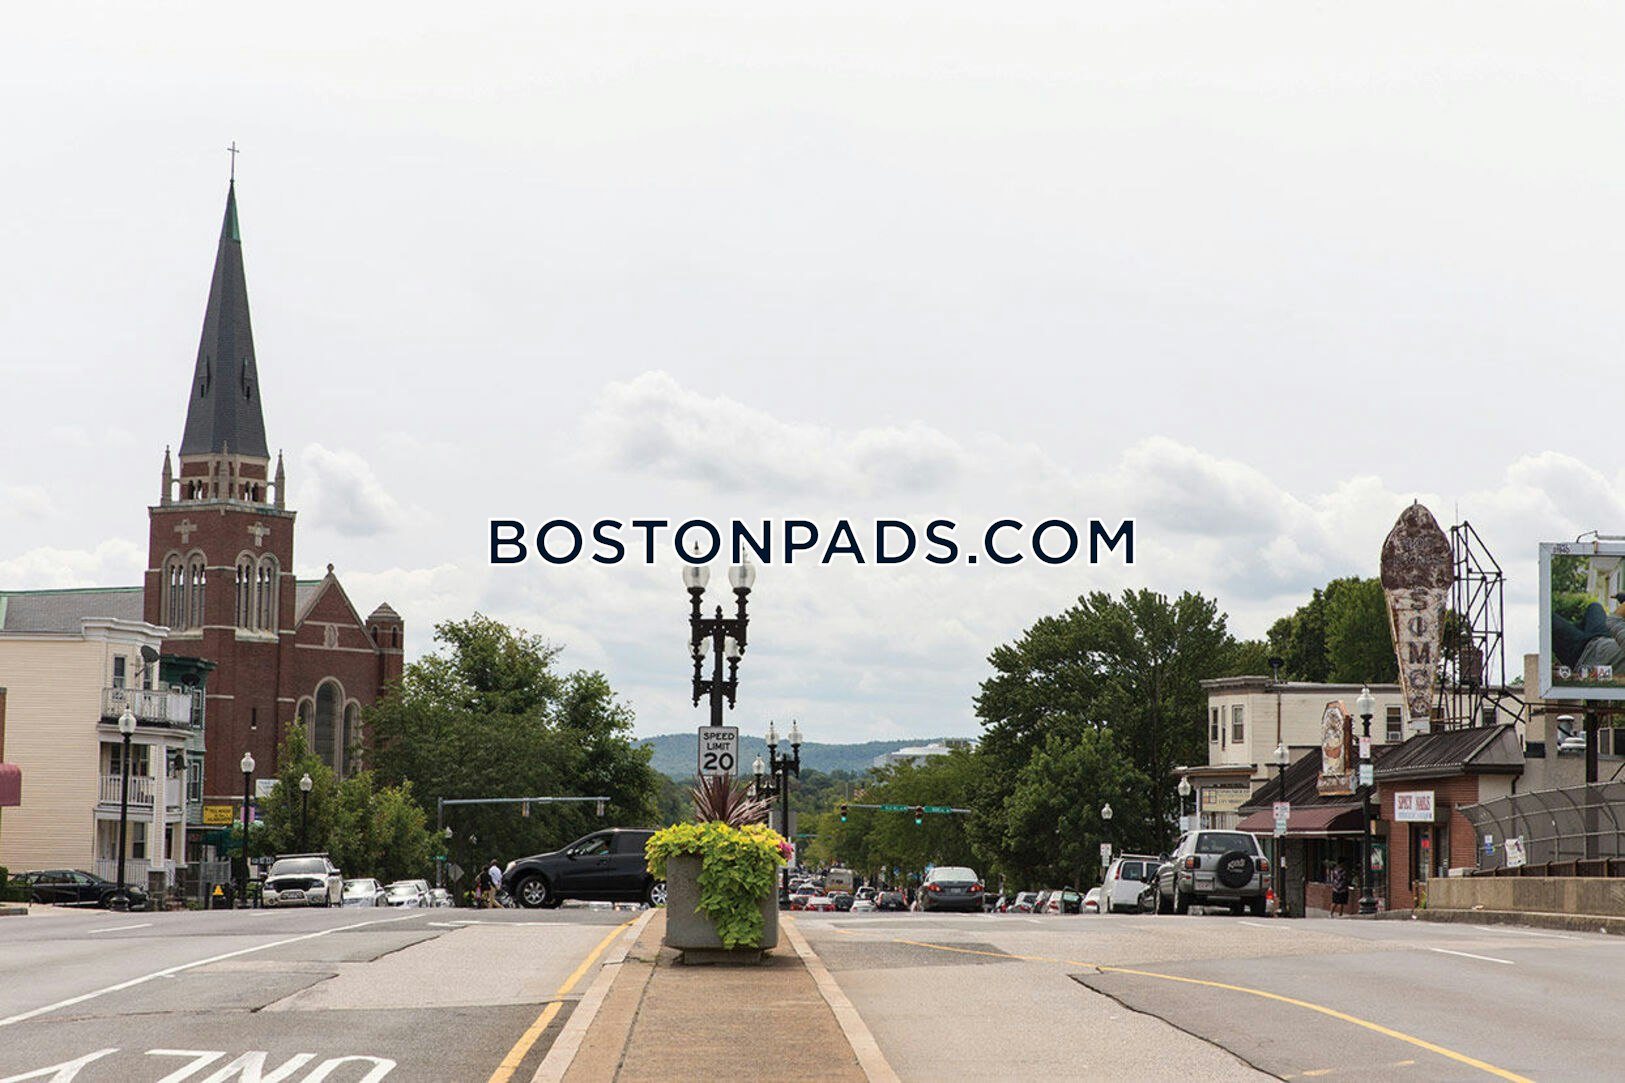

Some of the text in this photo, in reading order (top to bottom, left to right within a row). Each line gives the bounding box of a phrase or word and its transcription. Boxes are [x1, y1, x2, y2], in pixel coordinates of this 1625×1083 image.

[703, 732, 735, 740] SPEED
[706, 742, 731, 750] LIMIT
[703, 752, 734, 771] 20
